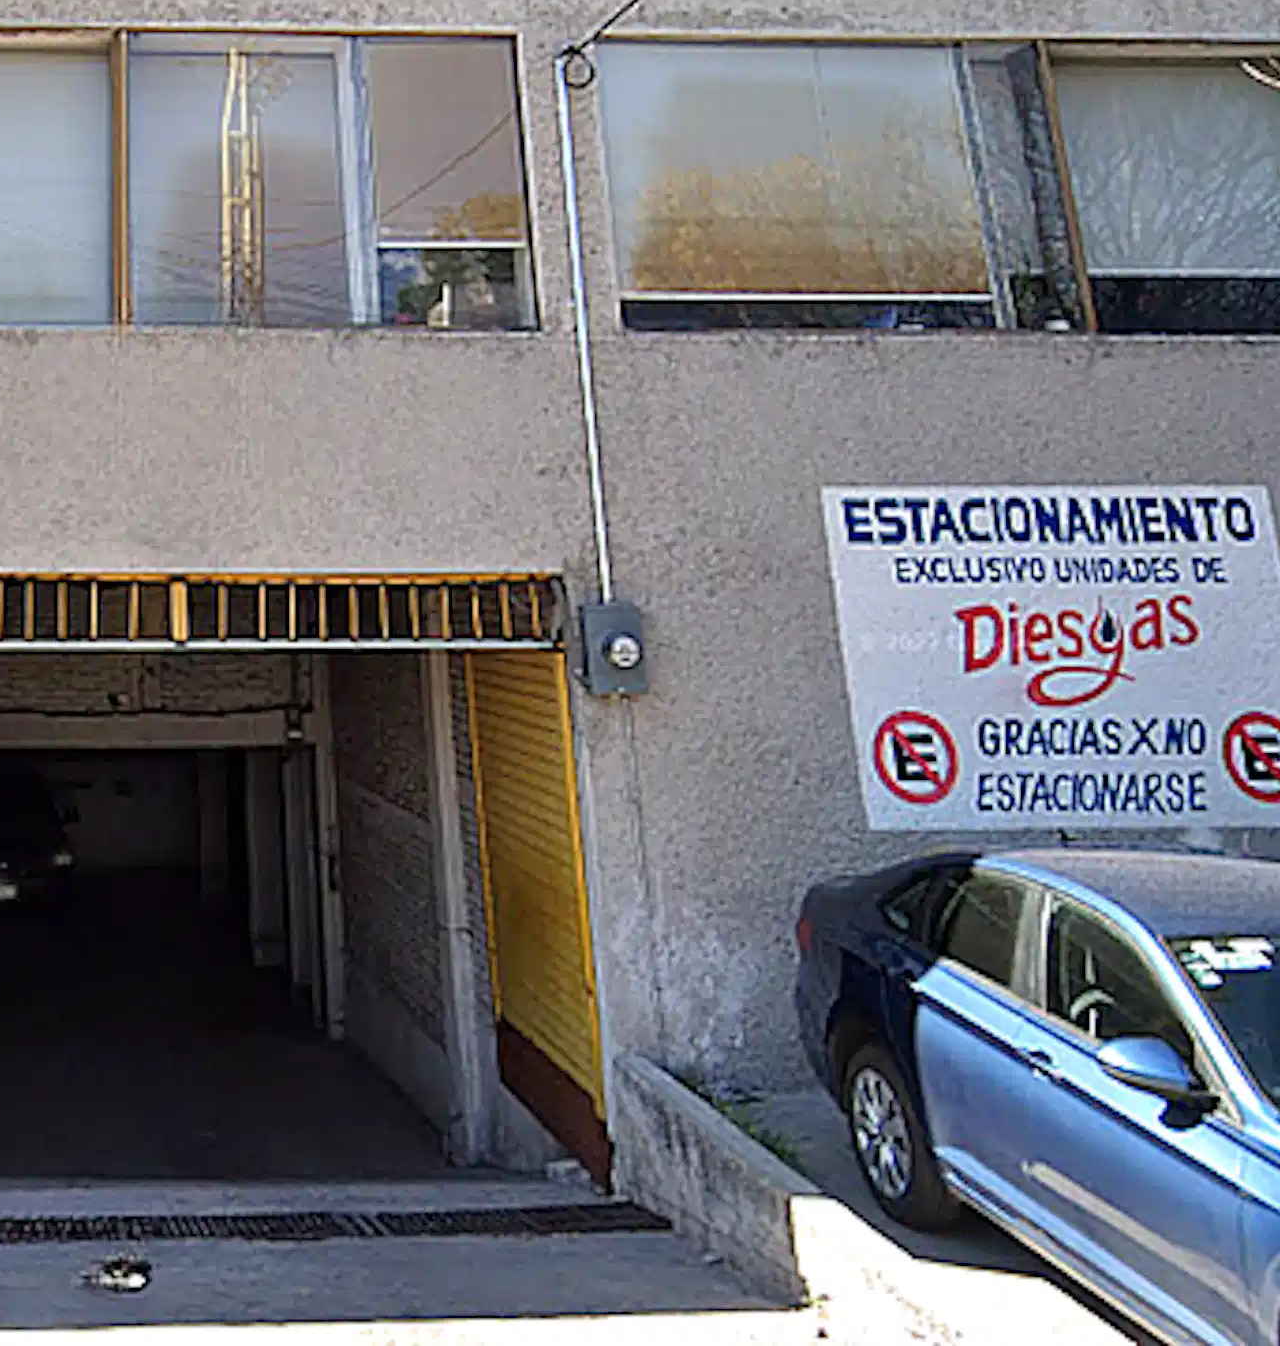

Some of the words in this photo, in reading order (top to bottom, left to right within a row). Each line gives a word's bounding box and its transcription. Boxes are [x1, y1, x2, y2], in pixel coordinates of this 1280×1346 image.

[841, 497, 1255, 543] ESTACIONAMIENTO
[895, 558, 1046, 584] EXCLUSIVO
[1055, 556, 1180, 583] UNIDADES
[1193, 556, 1228, 583] DE
[978, 718, 1122, 756] GRACIAS
[1164, 718, 1207, 755] NO
[976, 772, 1208, 813] ESTACIONARSE
